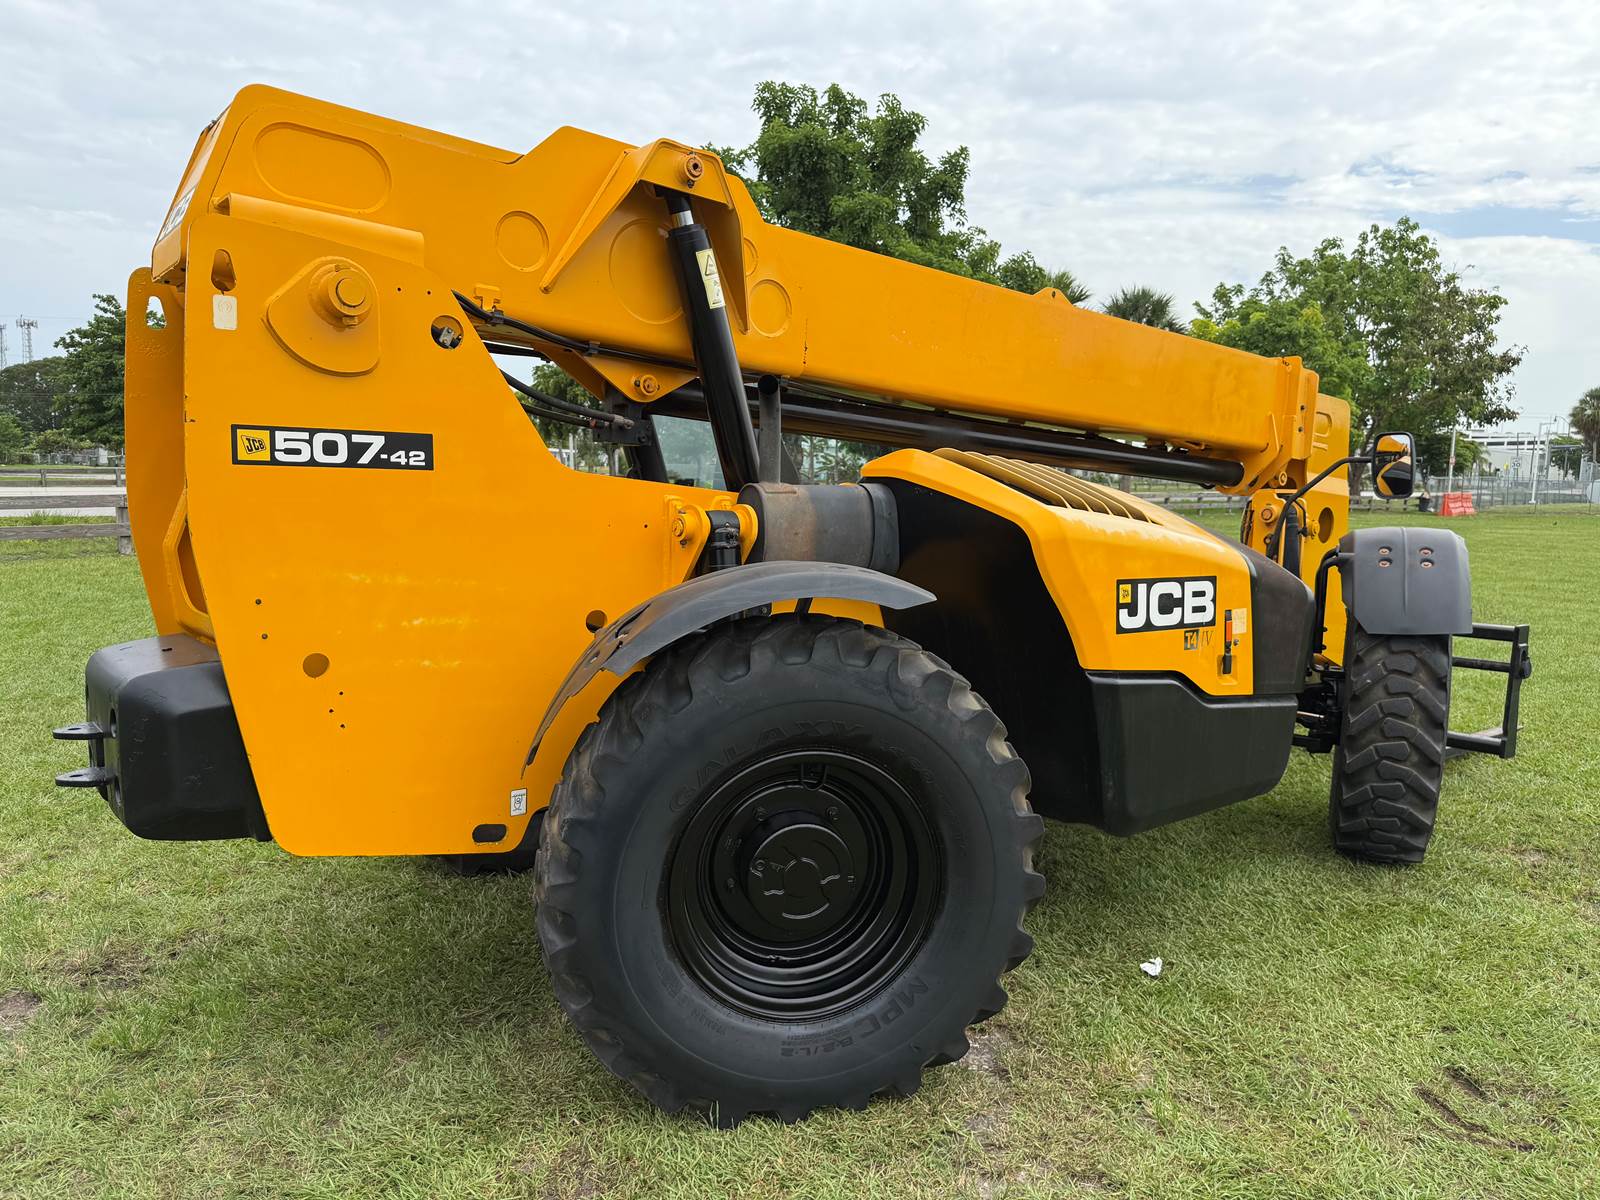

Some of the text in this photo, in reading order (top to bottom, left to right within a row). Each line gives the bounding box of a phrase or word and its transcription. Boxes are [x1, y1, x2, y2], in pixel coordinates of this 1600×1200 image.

[245, 430, 426, 466] JCB 507-42
[1118, 580, 1215, 629] JCB
[670, 719, 865, 812] GALAXY
[854, 976, 929, 1038] MPC
